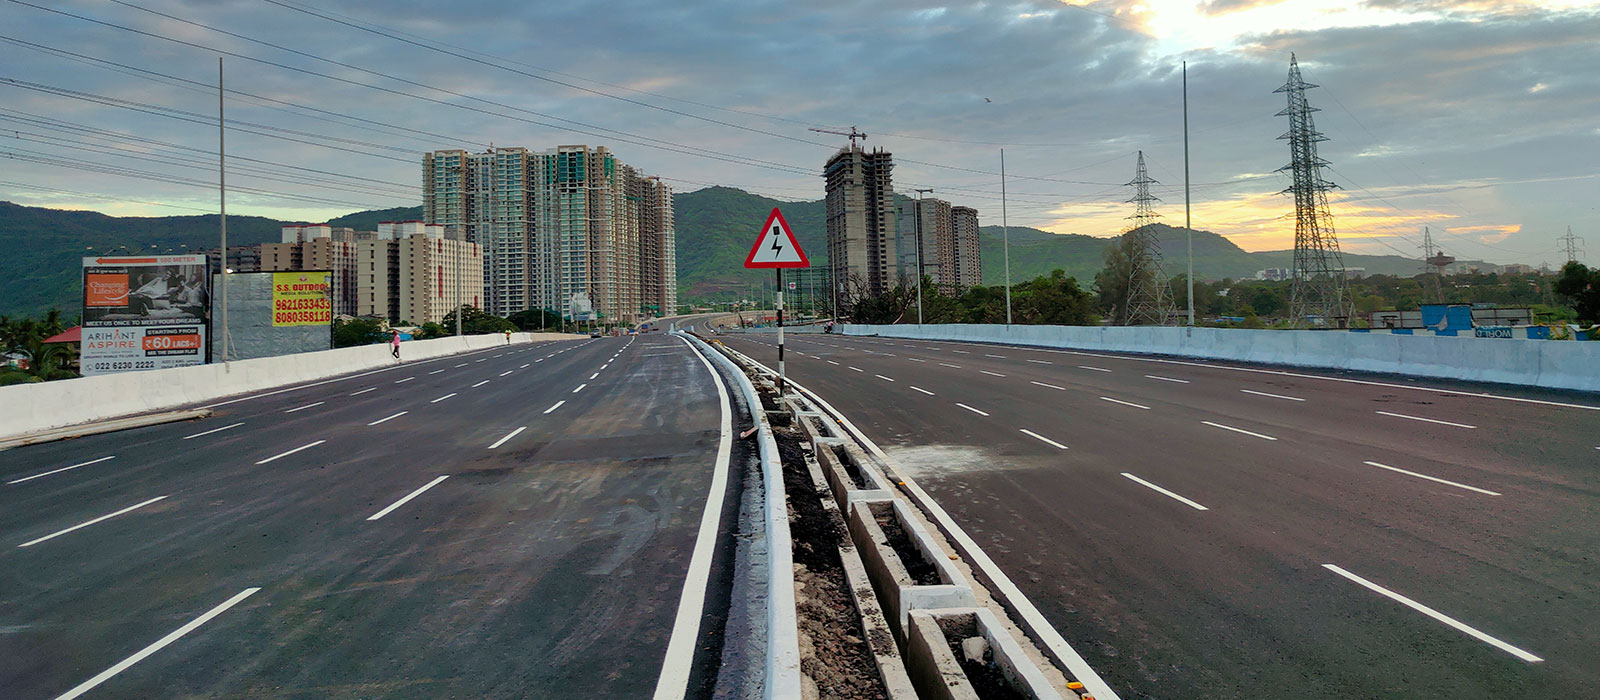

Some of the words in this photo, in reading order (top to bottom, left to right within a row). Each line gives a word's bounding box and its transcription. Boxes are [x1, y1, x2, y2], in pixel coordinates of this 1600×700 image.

[276, 299, 331, 310] 9821633433
[276, 311, 331, 323] 8080358118
[88, 330, 136, 340] ARIHANT
[88, 341, 136, 349] ASPIRE
[95, 362, 110, 370] 022
[113, 361, 132, 369] 6230
[135, 361, 155, 369] 2222
